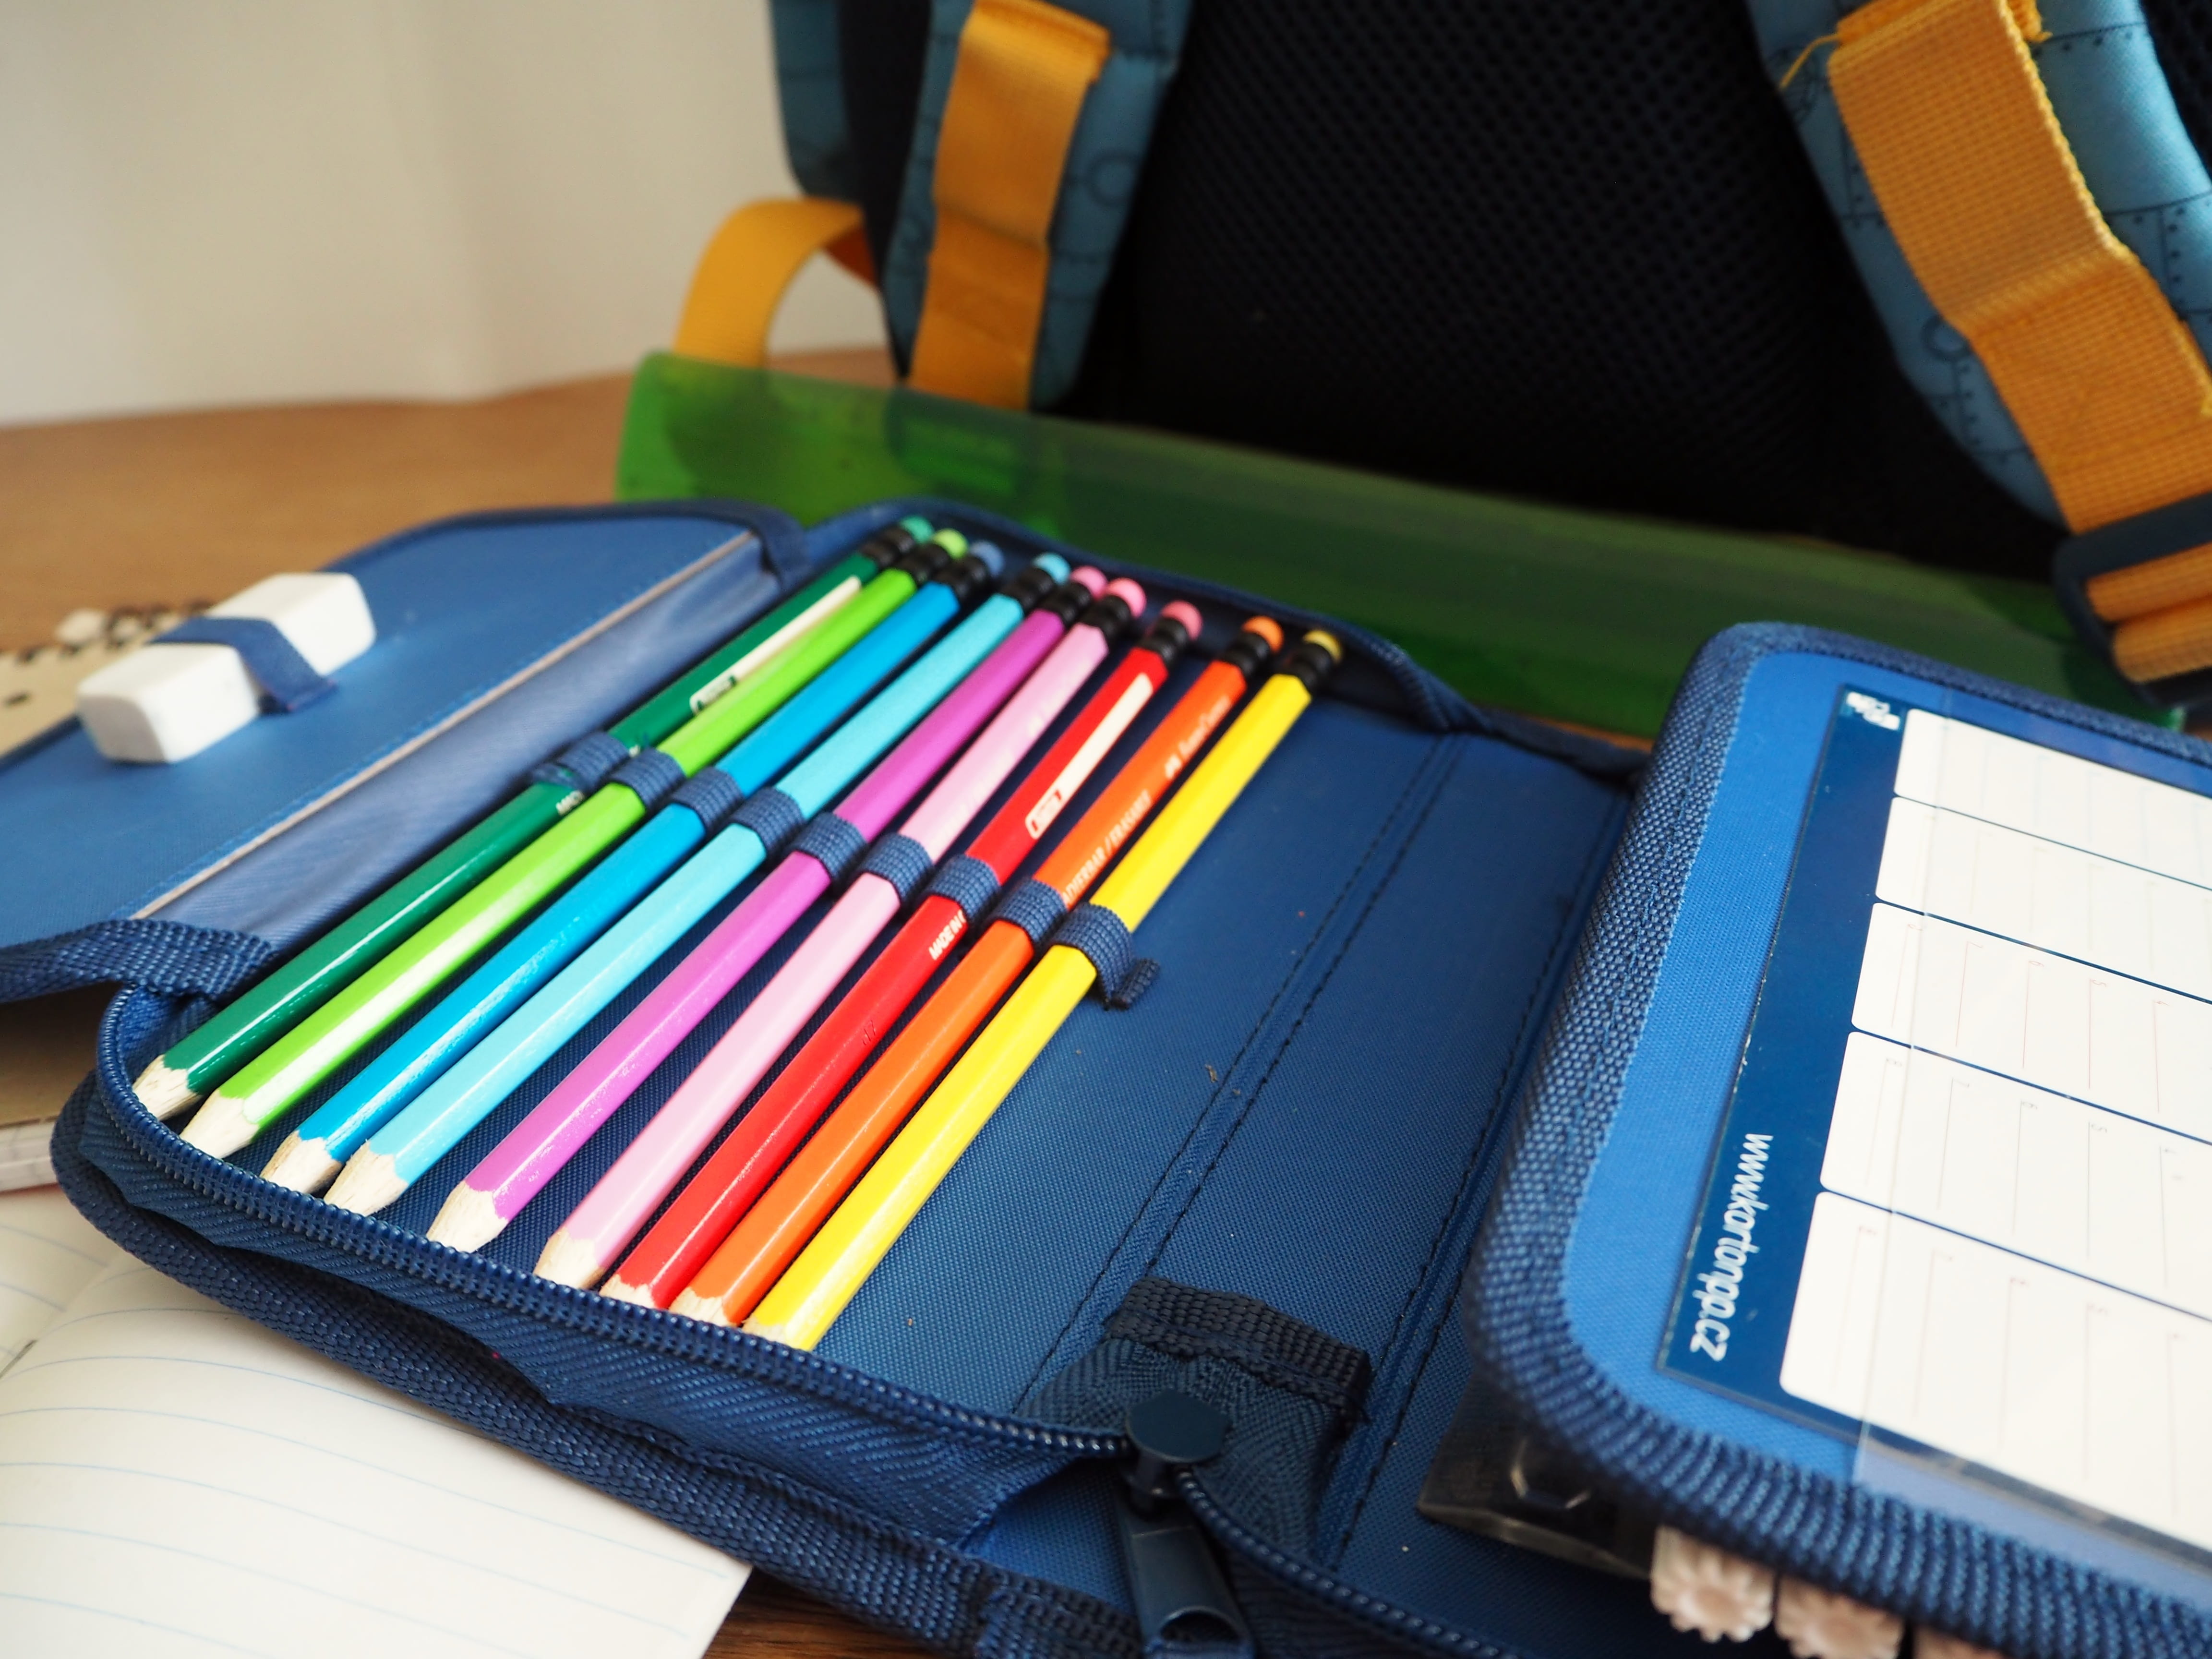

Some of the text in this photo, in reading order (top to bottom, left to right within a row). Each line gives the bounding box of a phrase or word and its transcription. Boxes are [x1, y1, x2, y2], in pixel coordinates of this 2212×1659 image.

[1061, 846, 1106, 905] ADIERBAR
[928, 925, 955, 960] MADE
[949, 915, 963, 935] IN
